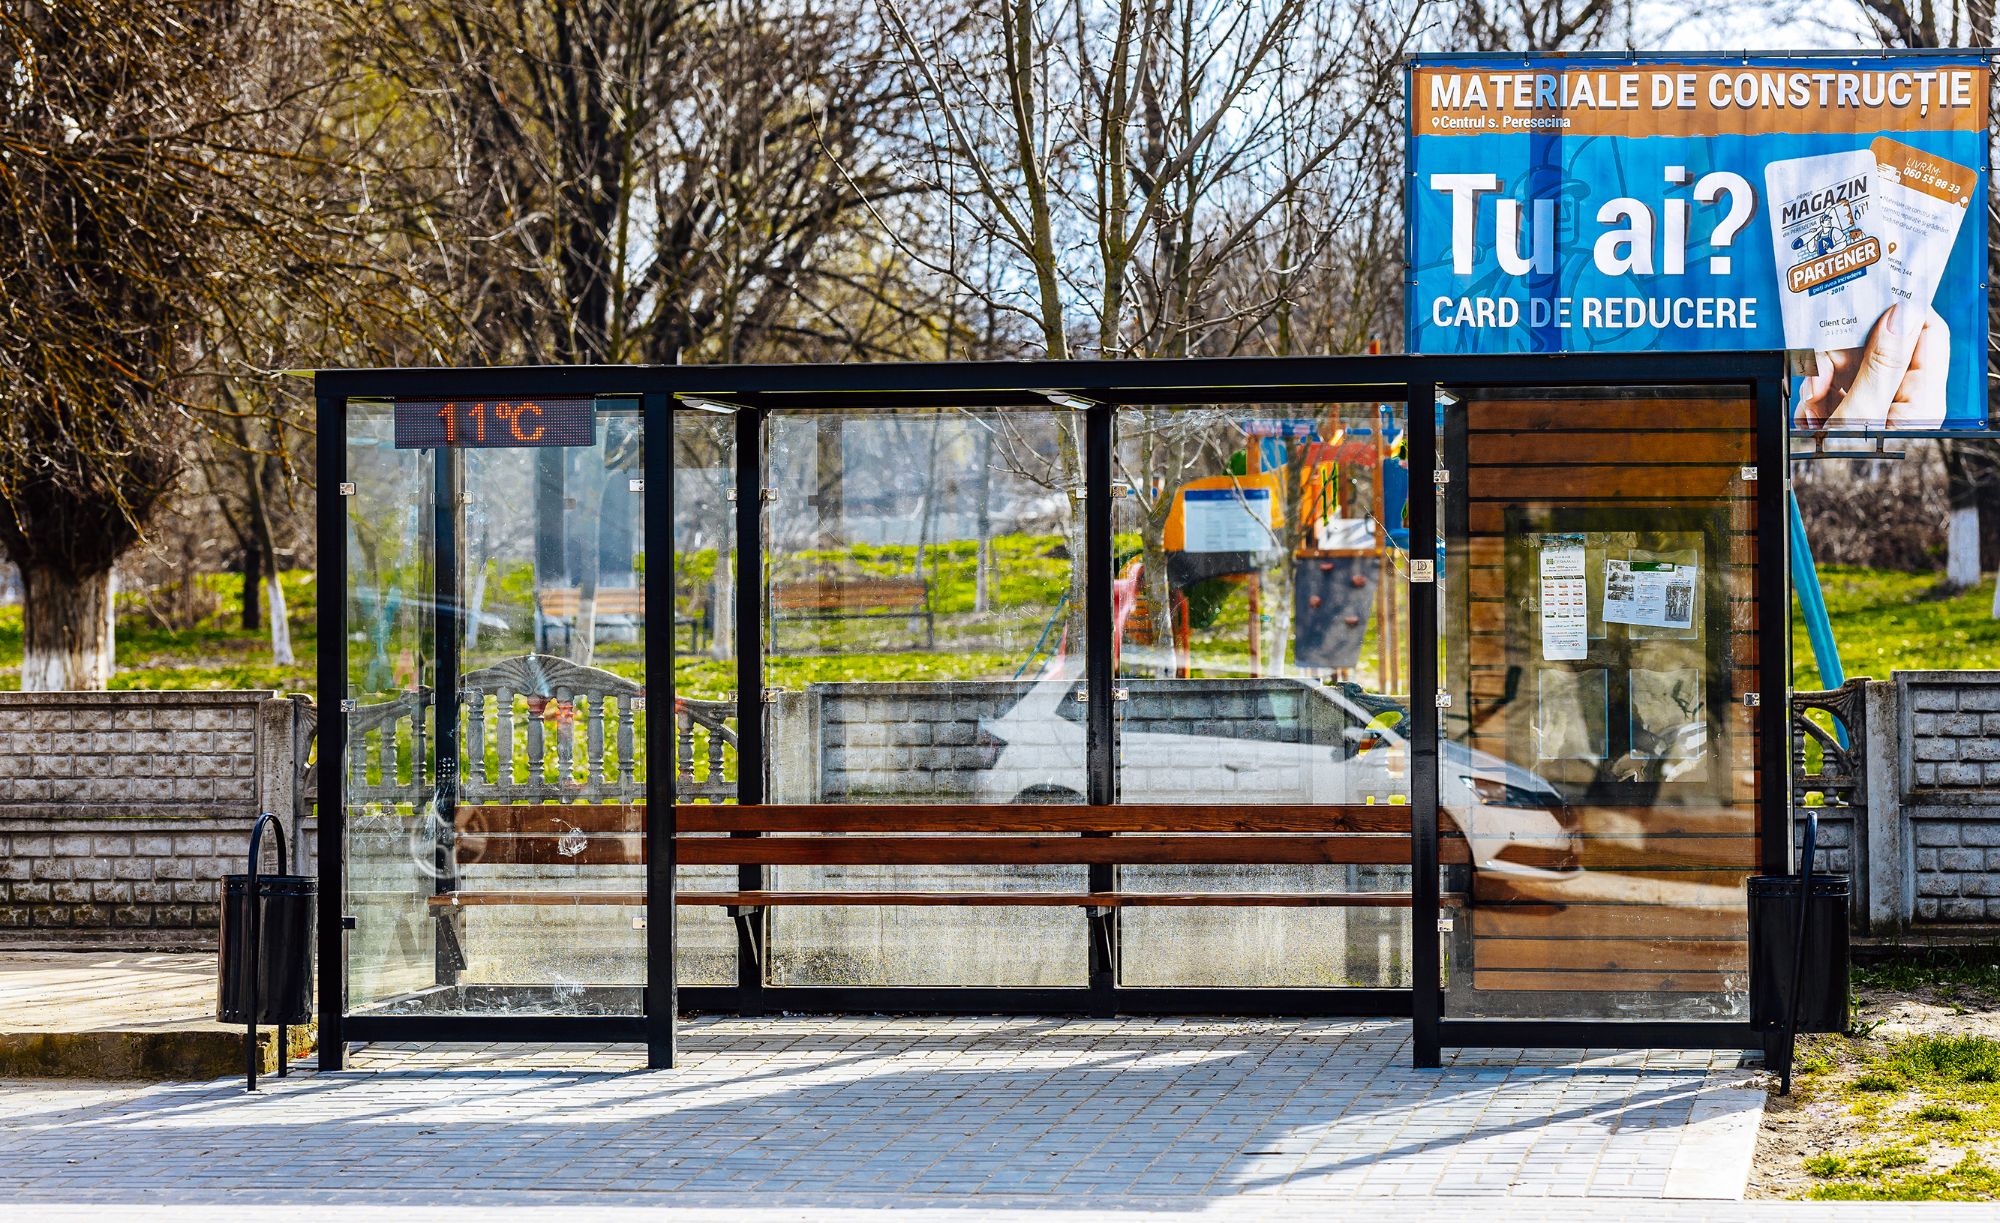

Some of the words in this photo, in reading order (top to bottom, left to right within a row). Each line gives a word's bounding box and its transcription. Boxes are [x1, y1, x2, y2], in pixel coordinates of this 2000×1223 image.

[1431, 73, 1640, 109] MATERIALE
[1651, 73, 1697, 108] DE
[1708, 71, 1971, 116] CONSTRUCȚIE
[1440, 115, 1486, 129] Centrul
[1488, 117, 1500, 129] s.
[1503, 115, 1571, 129] Peresecina
[1782, 175, 1867, 225] MAGAZIN
[1903, 167, 1922, 180] 060
[1921, 174, 1934, 185] 55
[1935, 178, 1948, 190] 88
[1948, 183, 1961, 194] 33
[1430, 173, 1554, 277] Tu
[1593, 165, 1755, 277] ai?
[1793, 242, 1877, 289] PARTENER
[1432, 296, 1518, 328] CARD
[1530, 296, 1571, 328] DE
[1582, 296, 1758, 329] REDUCERE
[1819, 319, 1840, 328] Client
[1841, 316, 1858, 326] Card
